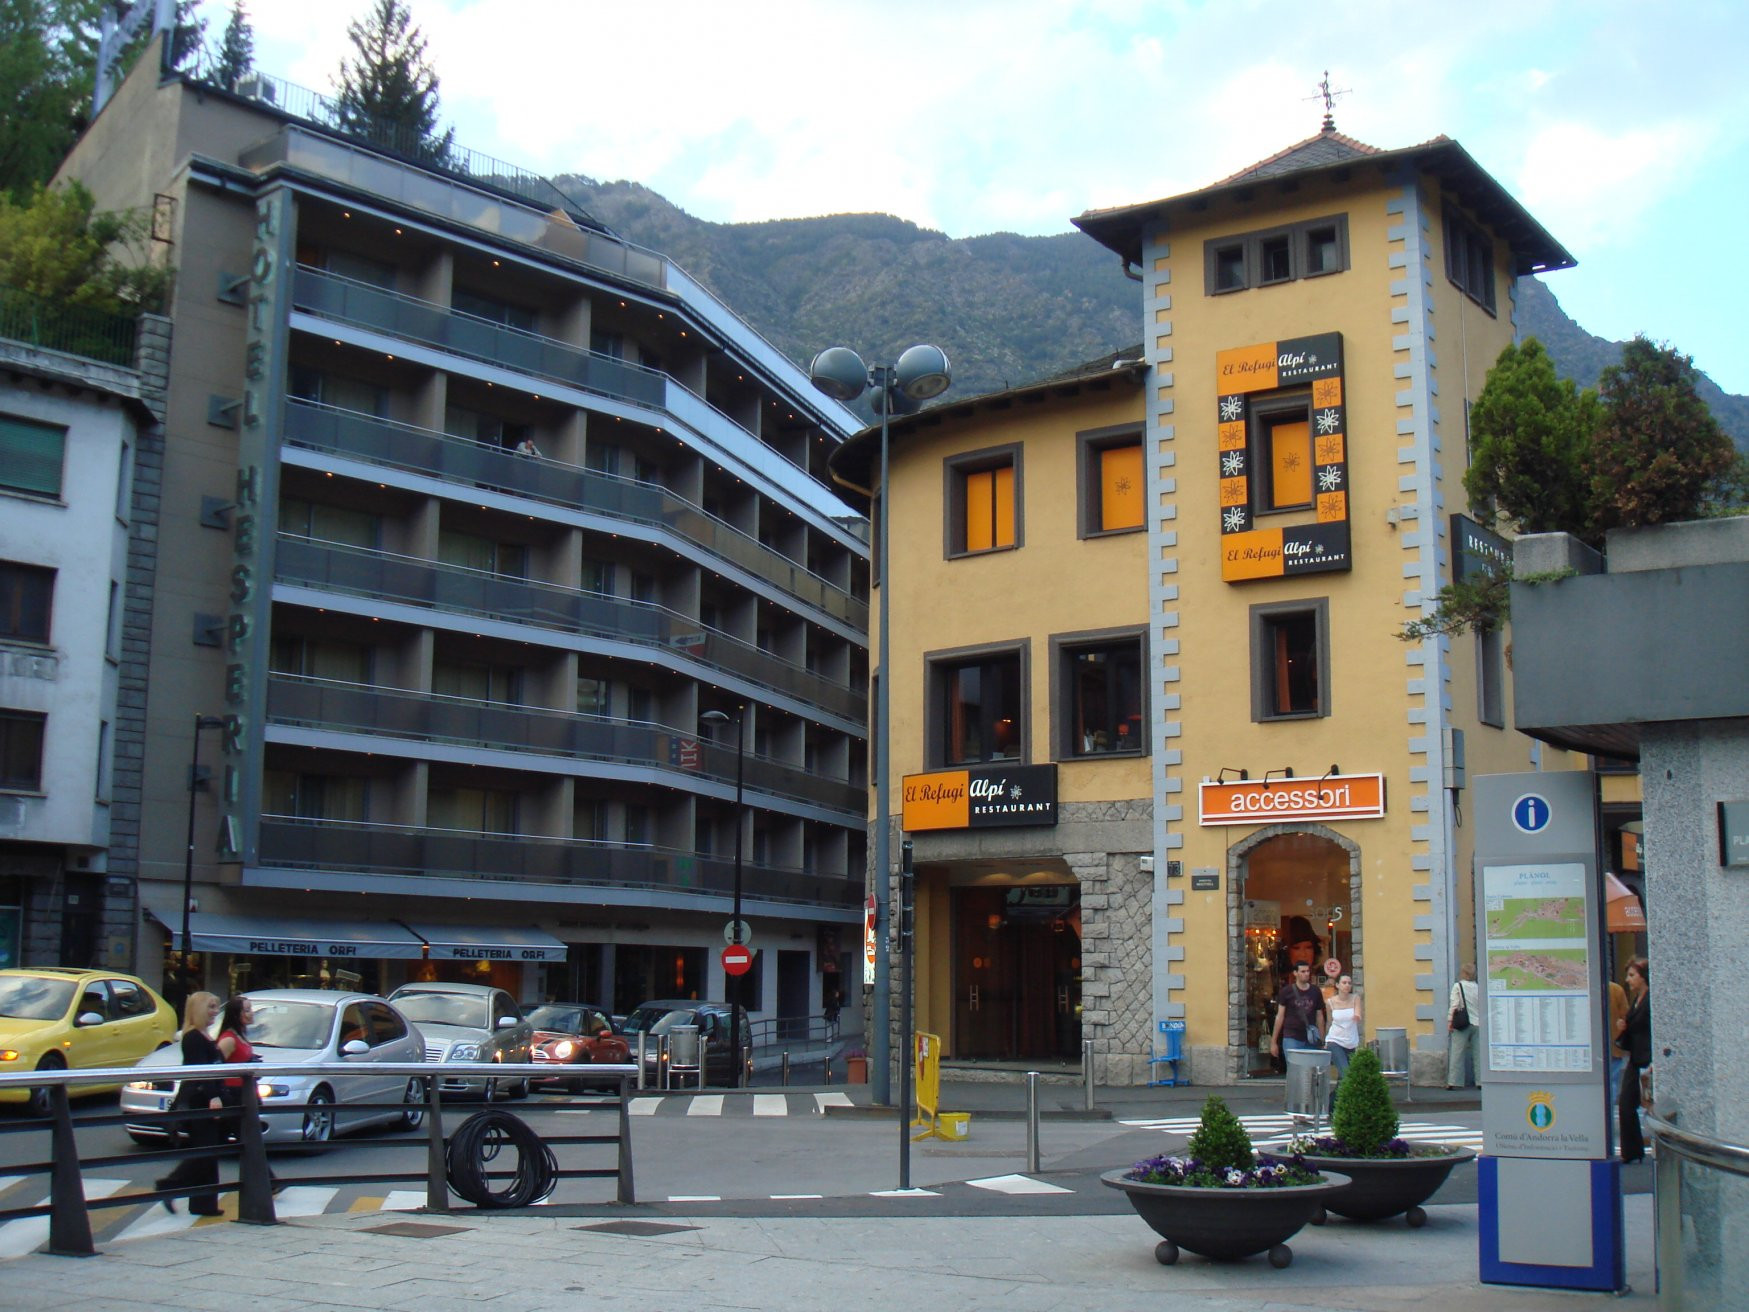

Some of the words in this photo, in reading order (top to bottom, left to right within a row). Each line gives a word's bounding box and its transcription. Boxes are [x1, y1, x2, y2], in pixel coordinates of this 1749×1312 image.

[246, 201, 275, 428] HOTEL
[1223, 364, 1233, 376] El
[1238, 358, 1276, 374] Refugi
[1278, 351, 1306, 368] Alpí
[1282, 363, 1338, 377] RESTAURANT
[1227, 550, 1239, 562] El
[1242, 546, 1281, 561] Refugi
[1284, 540, 1312, 557] Alpí
[1288, 553, 1345, 566] RESTAURANT
[217, 465, 258, 855] HESPERIA
[905, 786, 916, 803] El
[919, 783, 964, 805] Refugi
[969, 778, 1007, 801] Alpí
[1230, 784, 1351, 812] accessori
[974, 802, 1051, 814] RESTAURANT
[250, 941, 319, 955] PELLETERIA
[329, 945, 357, 956] ORFI
[453, 948, 513, 959] PELLETERIA
[521, 950, 545, 960] ORFI
